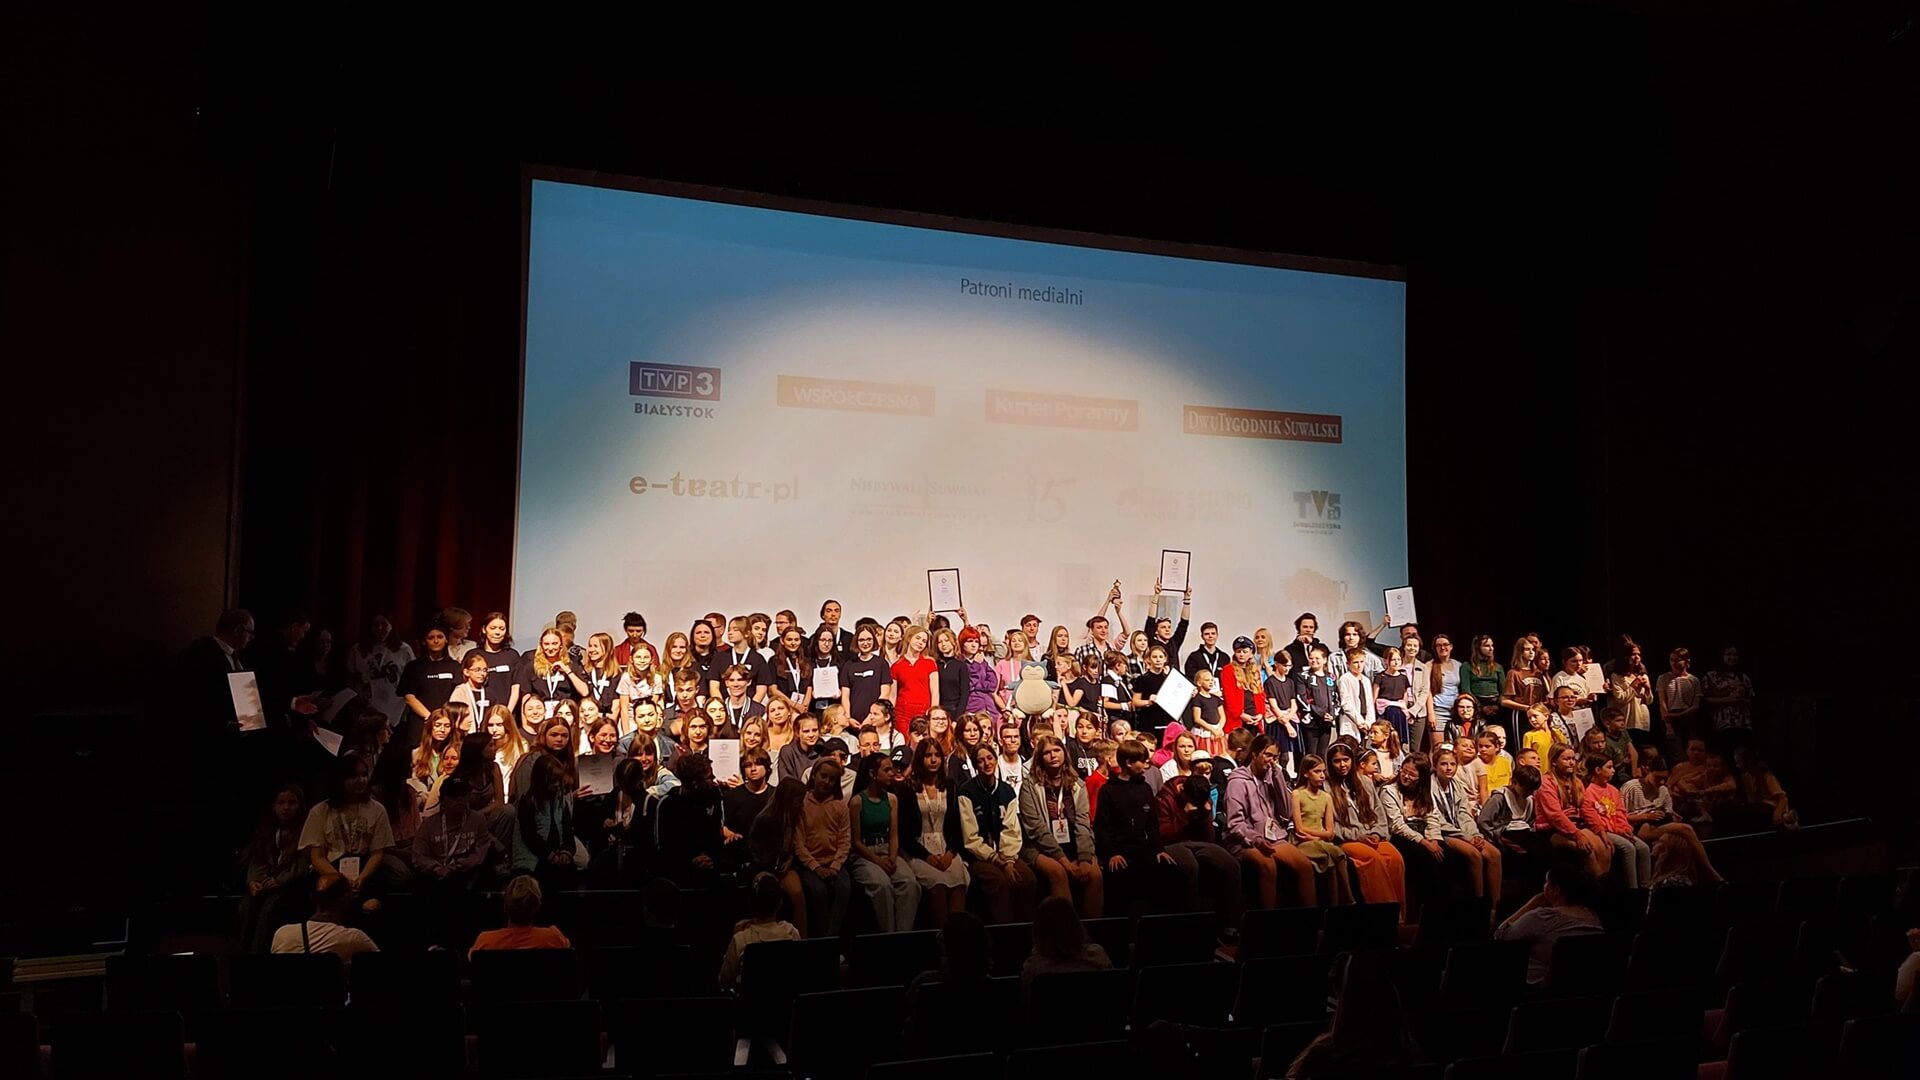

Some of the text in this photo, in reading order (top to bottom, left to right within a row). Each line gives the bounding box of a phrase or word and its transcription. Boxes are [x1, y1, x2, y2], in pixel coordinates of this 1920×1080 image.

[960, 277, 1084, 306] Patroni medialni
[642, 371, 714, 396] TVP 3
[633, 402, 715, 420] BIAŁYSTOK
